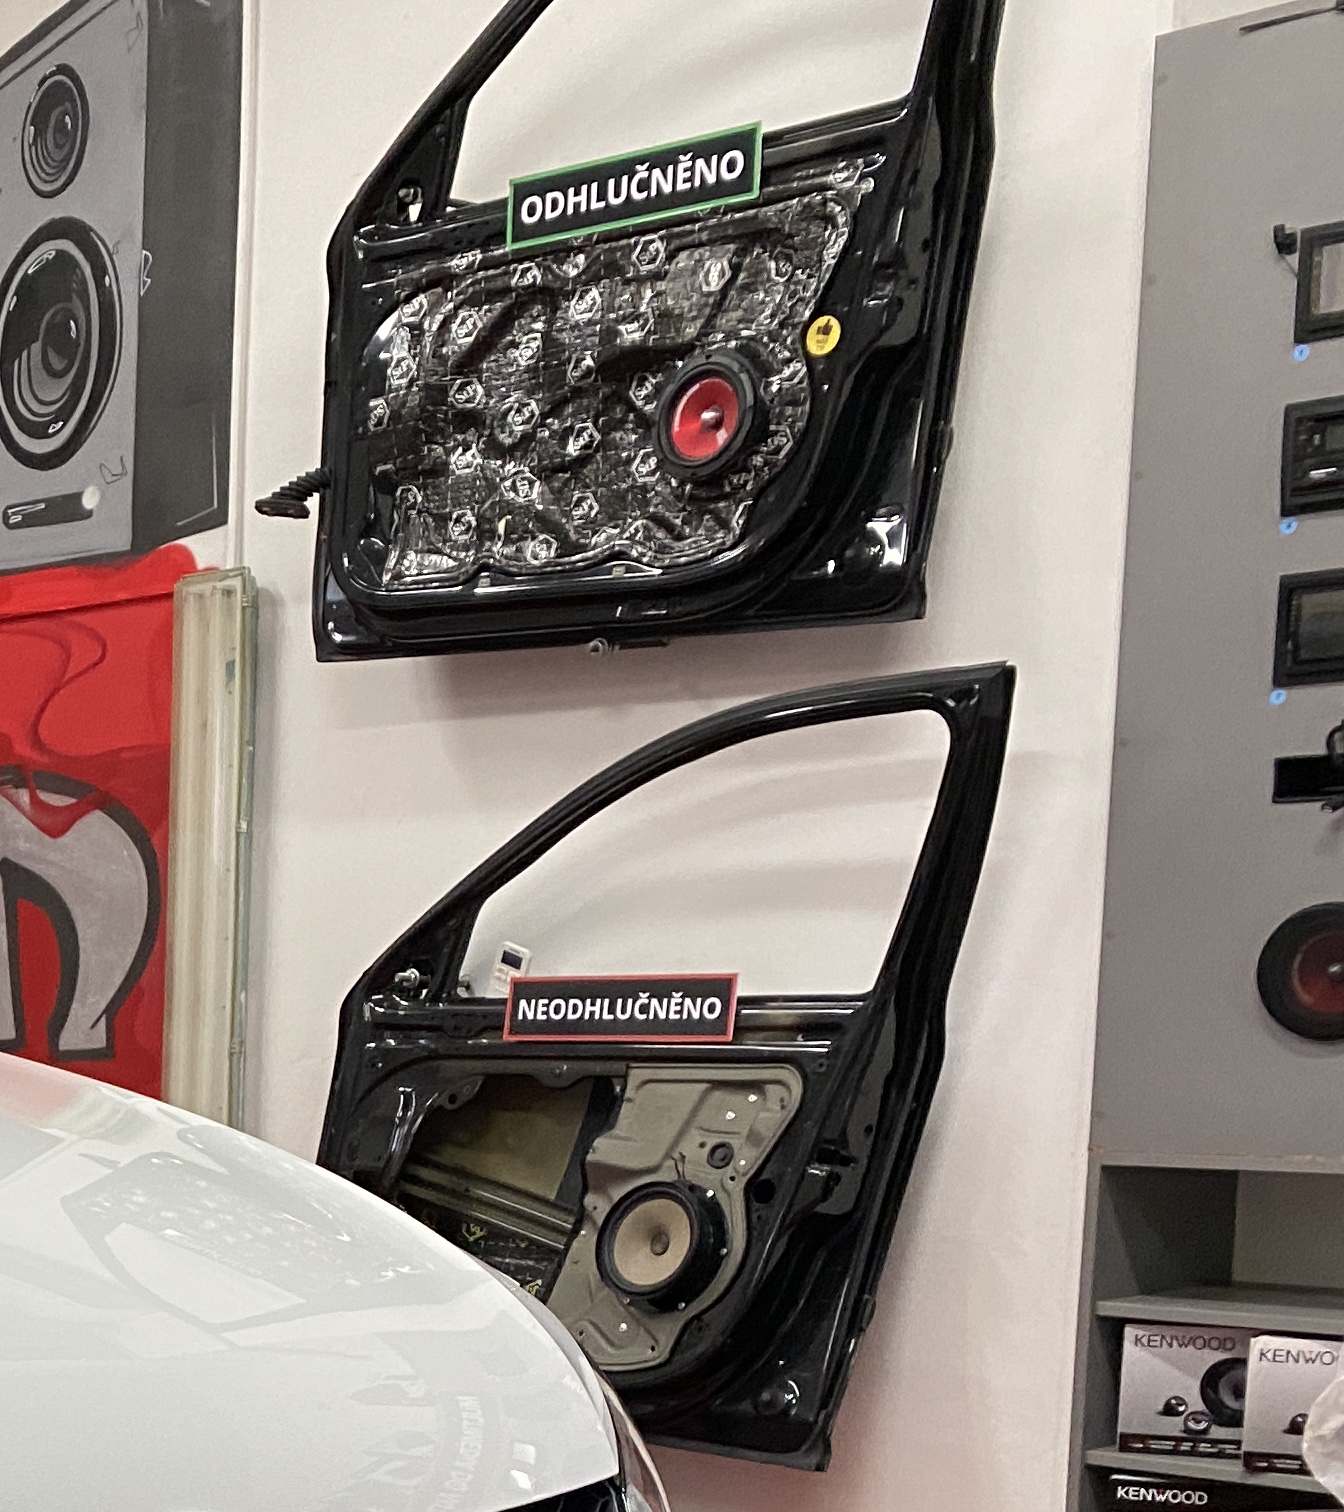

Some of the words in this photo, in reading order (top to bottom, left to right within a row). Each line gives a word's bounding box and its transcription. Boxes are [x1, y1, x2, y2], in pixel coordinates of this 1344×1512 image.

[519, 148, 745, 224] ODHLUČNĚNO
[517, 991, 723, 1021] NEODHLUČNĚNO
[1134, 1333, 1236, 1352] KENWOOD
[1259, 1348, 1340, 1366] KENWO
[1116, 1485, 1209, 1506] KENWOOD
